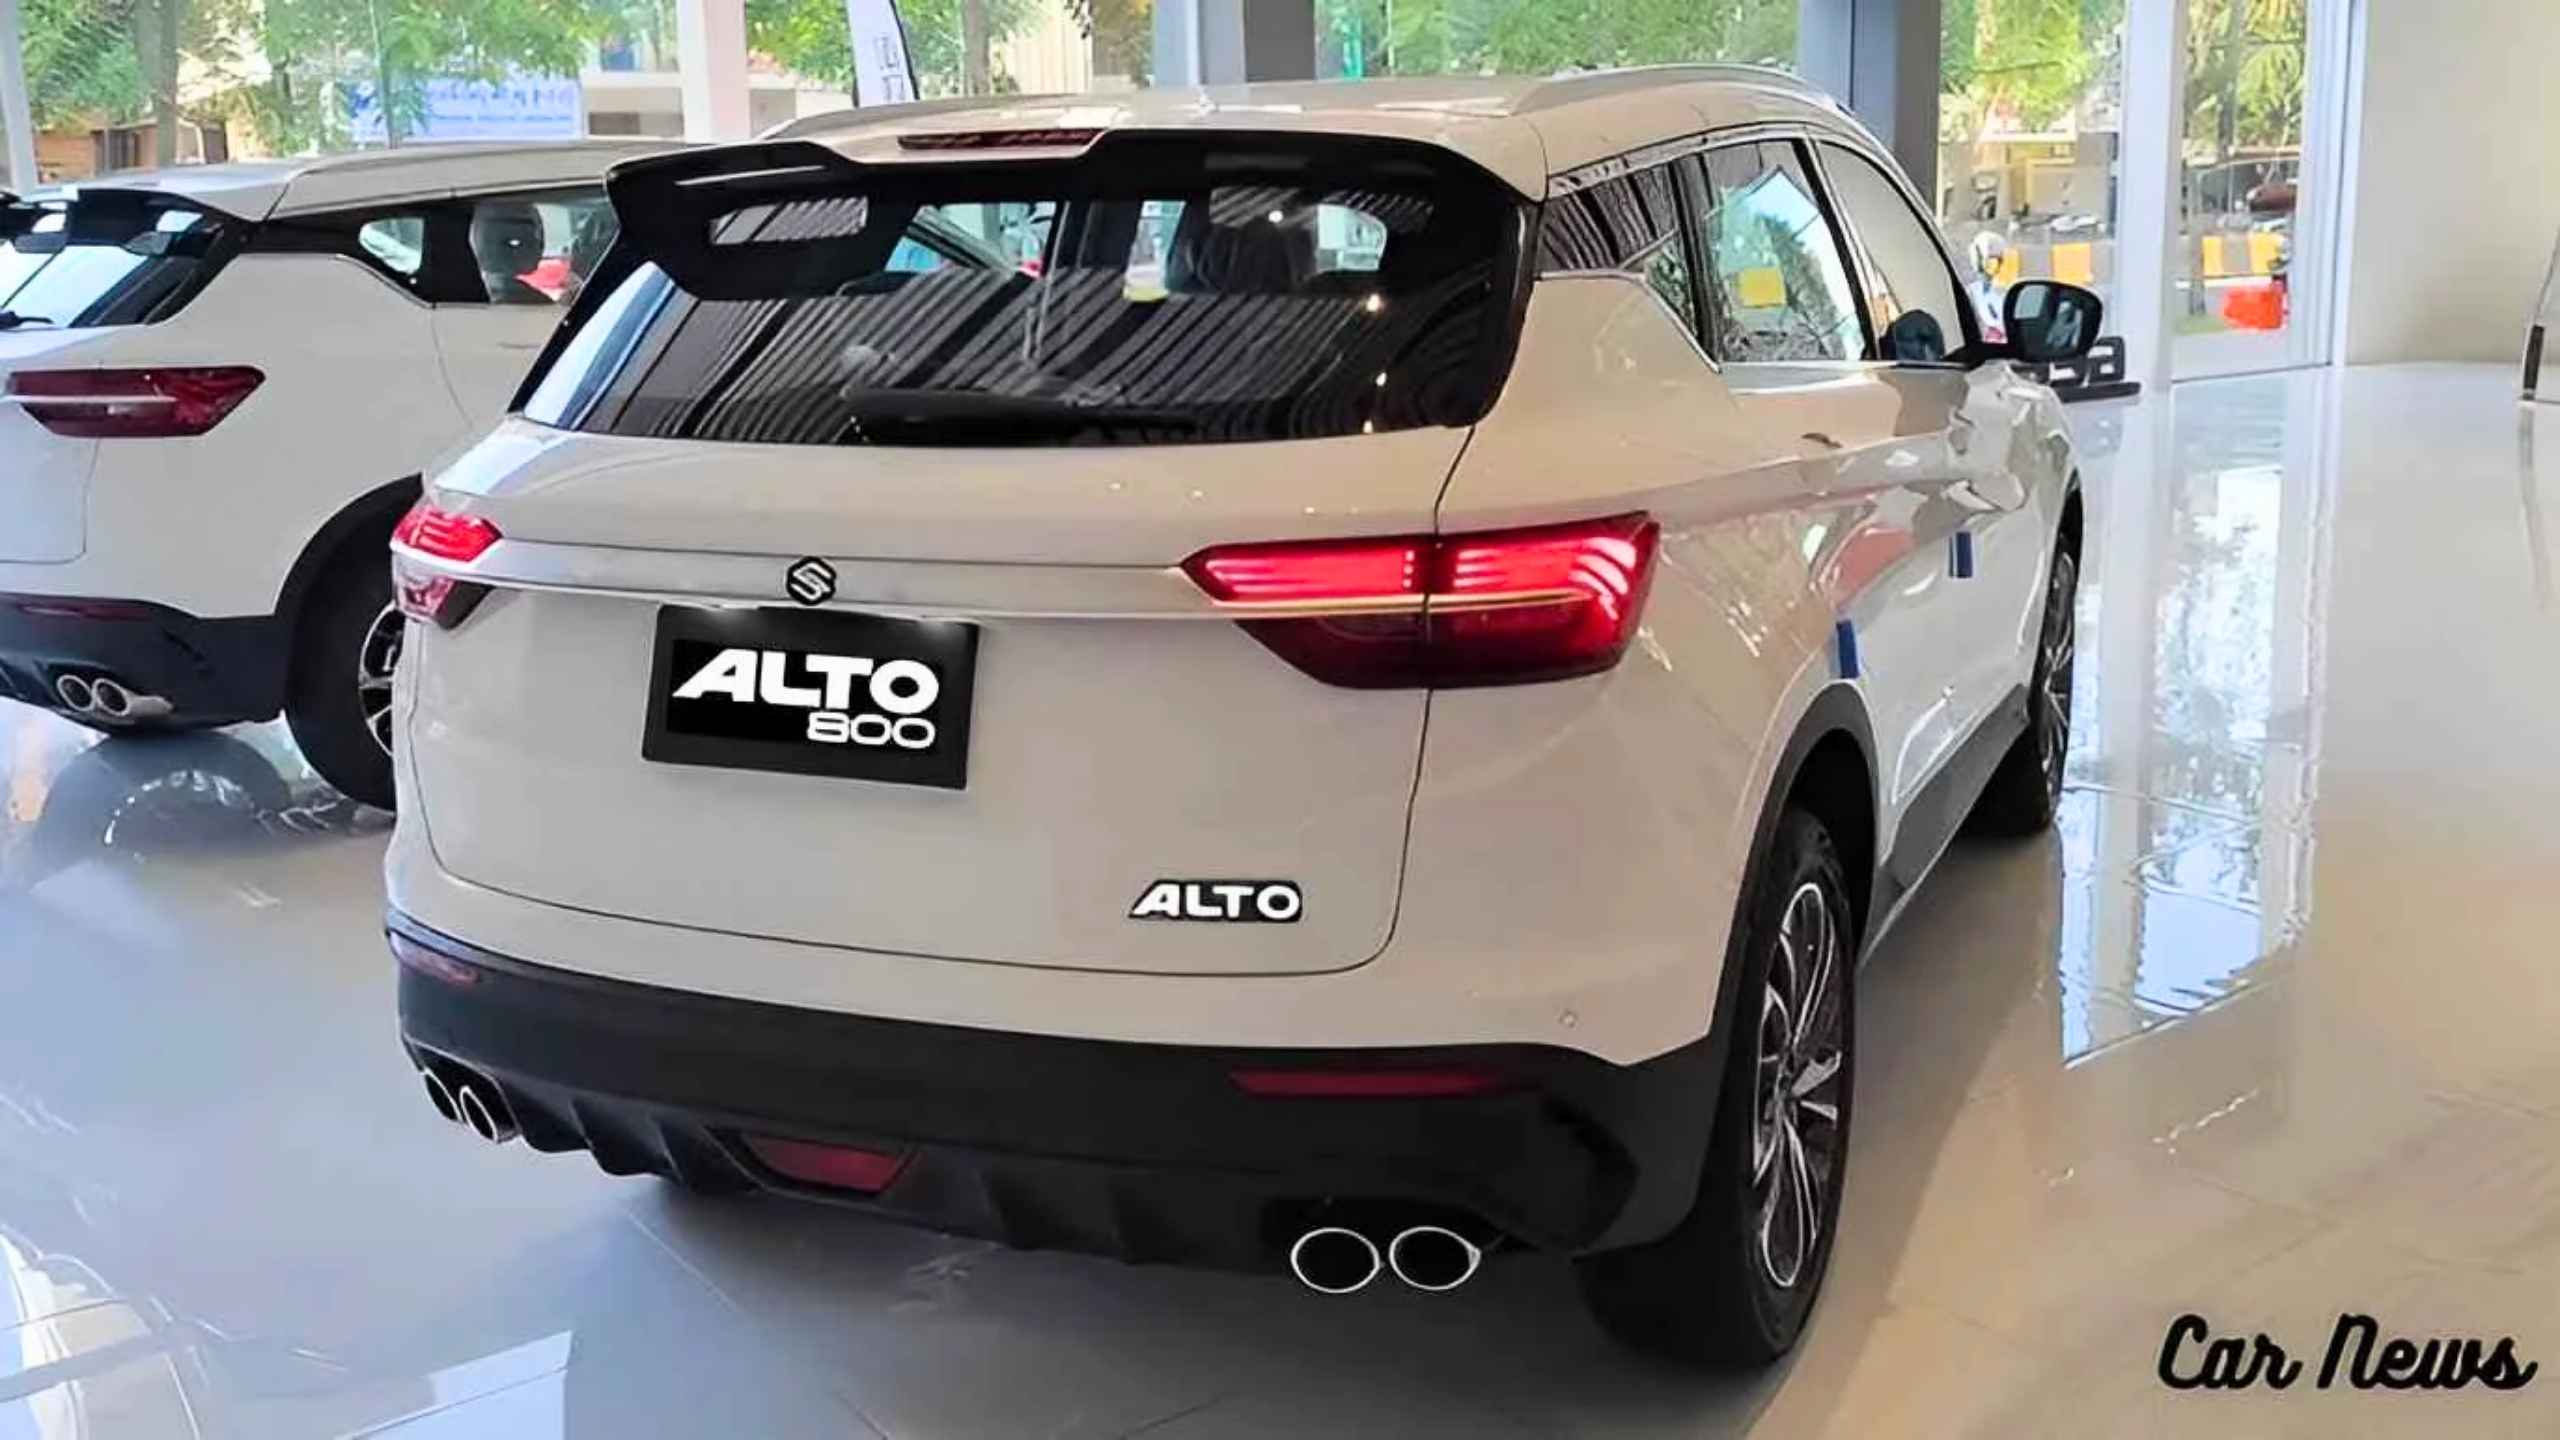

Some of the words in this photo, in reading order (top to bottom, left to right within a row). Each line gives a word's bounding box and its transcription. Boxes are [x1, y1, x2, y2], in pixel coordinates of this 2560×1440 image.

[672, 648, 940, 714] ALTO
[806, 711, 936, 749] 800
[1131, 883, 1300, 920] ALTO
